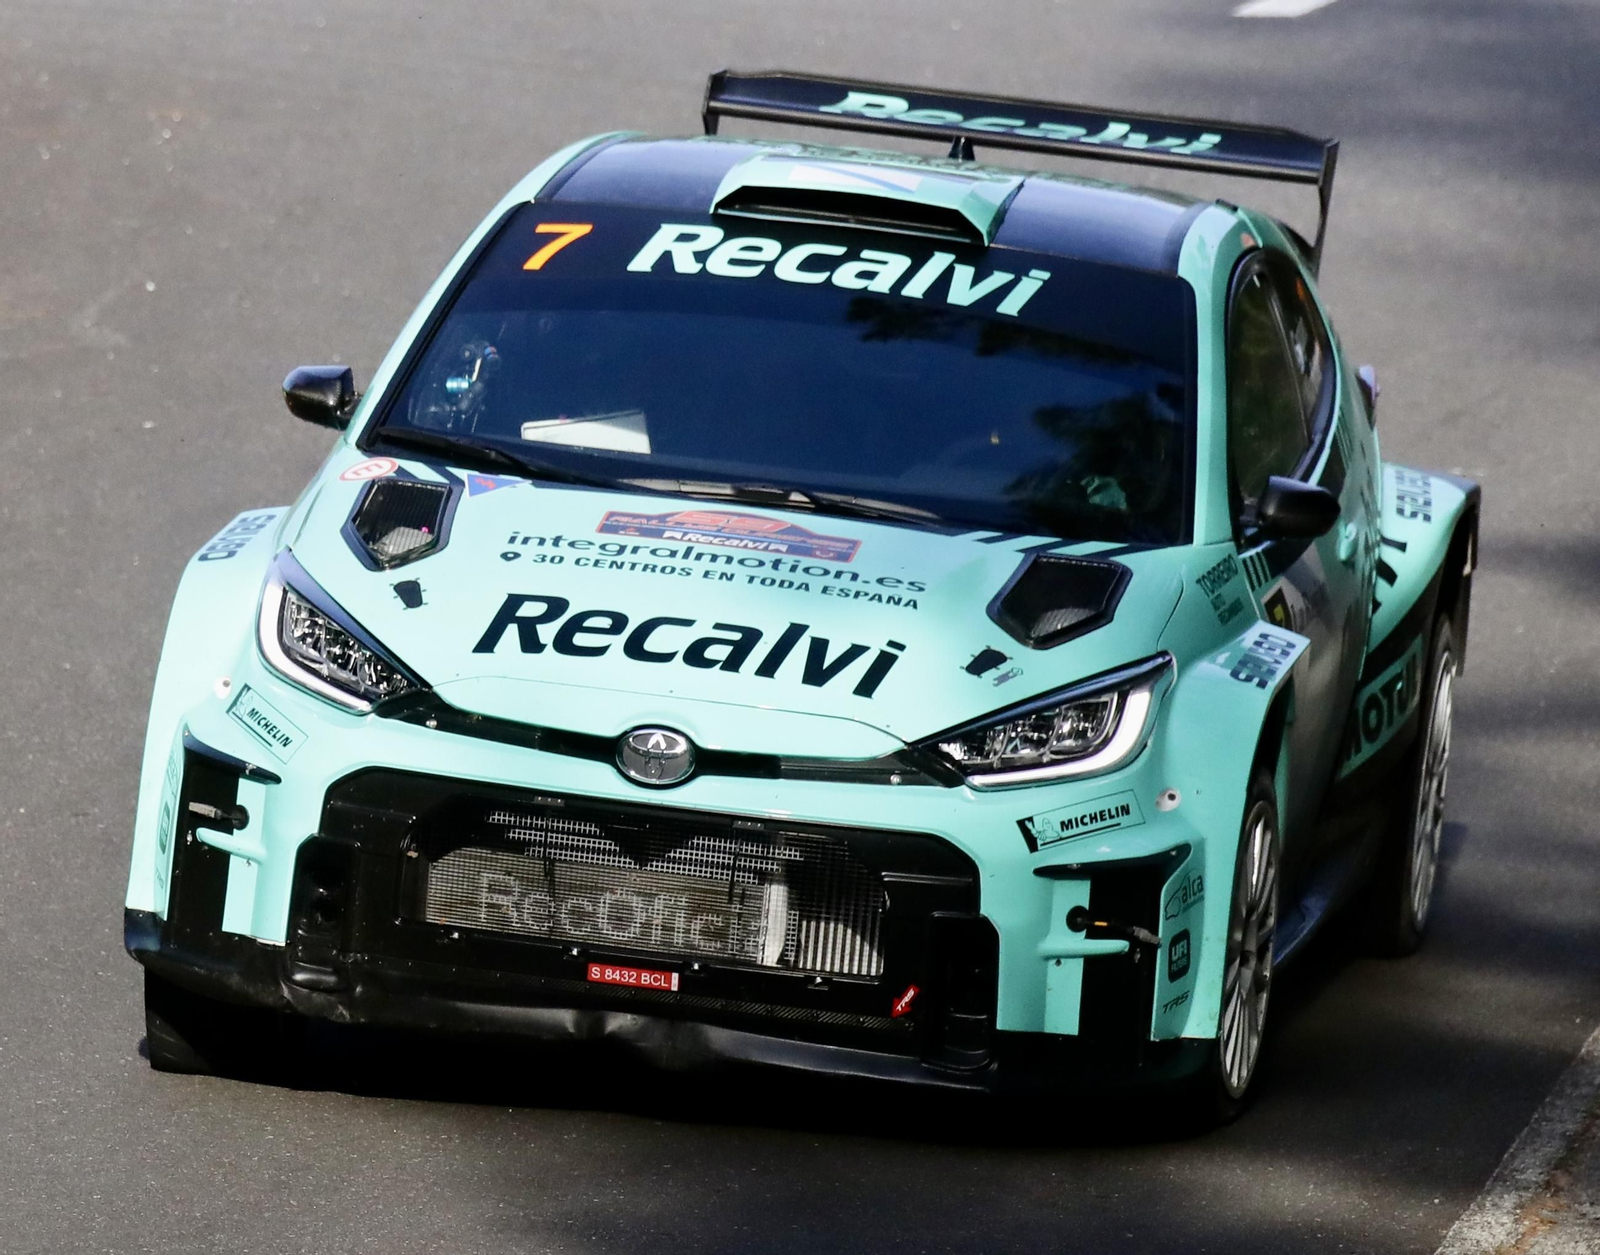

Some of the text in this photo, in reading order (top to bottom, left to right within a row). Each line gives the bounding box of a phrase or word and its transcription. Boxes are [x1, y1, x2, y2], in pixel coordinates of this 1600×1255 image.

[819, 91, 1222, 154] Recalvi
[523, 223, 594, 271] 7
[626, 222, 1051, 317] Recalvi
[506, 531, 928, 593] integralmotion.es
[683, 533, 768, 550] Recalvi
[532, 553, 920, 611] 30 CENTROS EN TODA ESPAÑA
[471, 592, 907, 700] Recalvi
[246, 707, 293, 748] MICHELIN
[1059, 803, 1131, 832] MICHELIN
[591, 967, 601, 979] S
[604, 968, 637, 983] 8432
[641, 972, 669, 987] BCL
